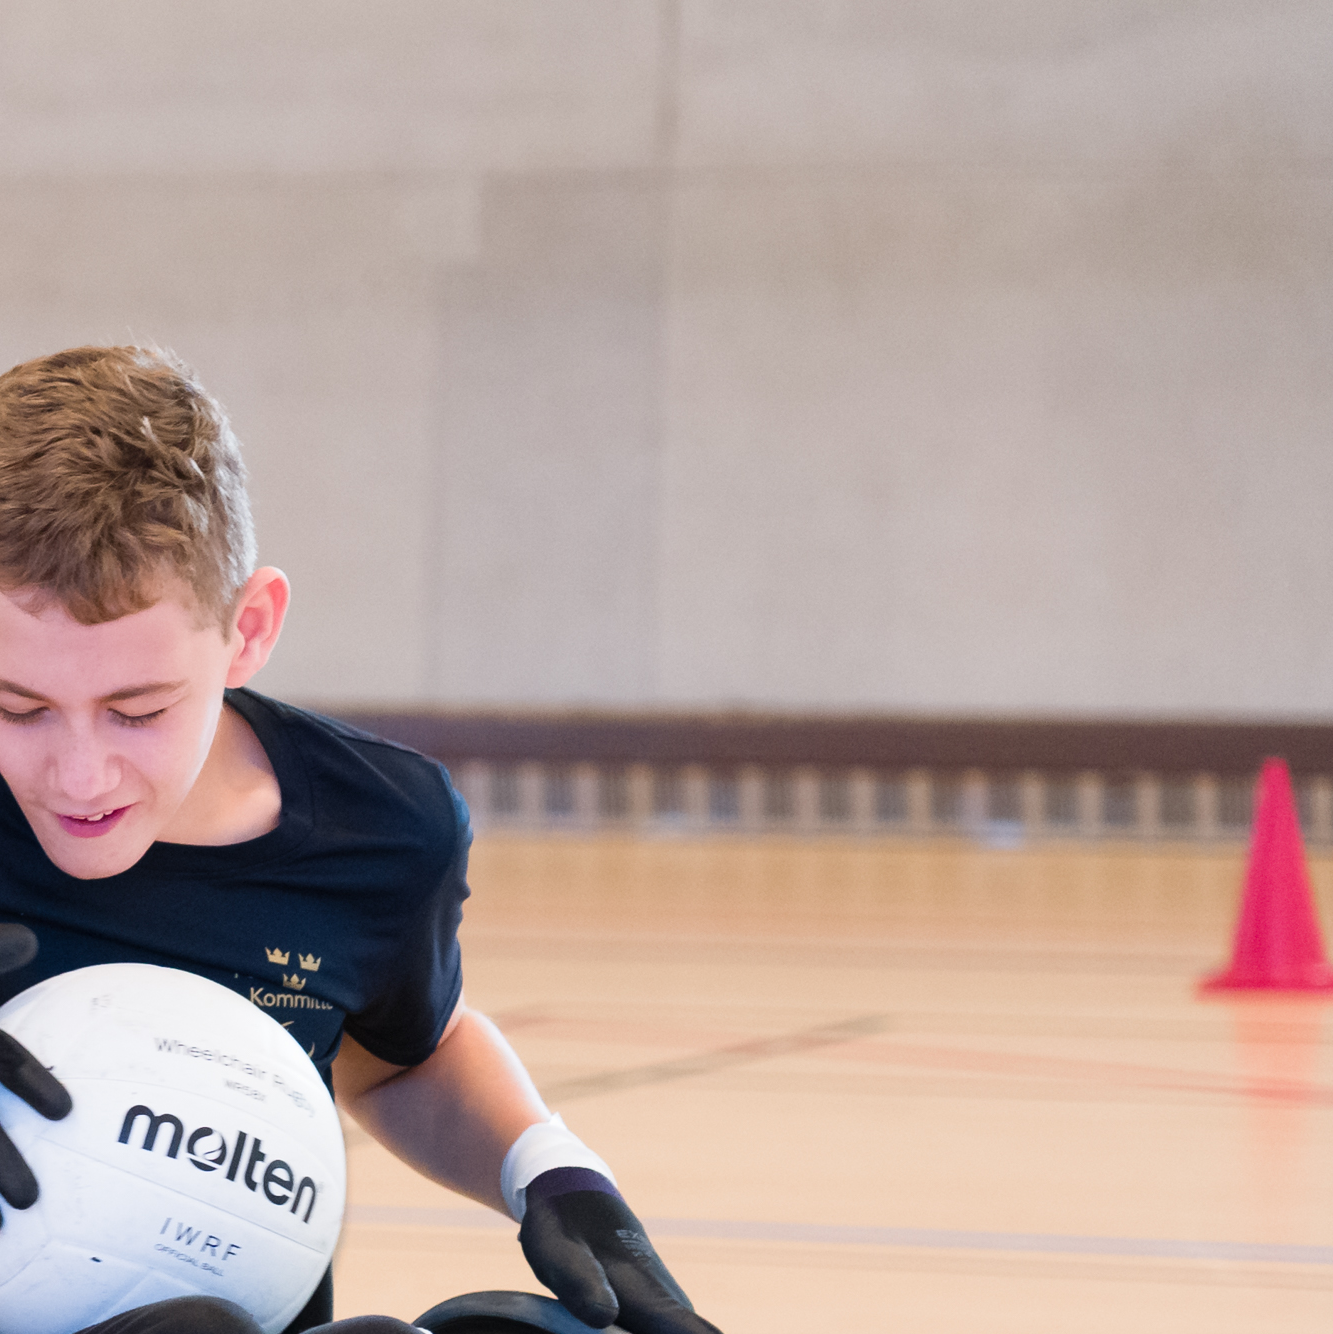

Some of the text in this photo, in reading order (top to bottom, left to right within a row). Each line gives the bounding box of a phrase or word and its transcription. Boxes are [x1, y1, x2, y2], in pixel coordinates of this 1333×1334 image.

[154, 1037, 316, 1118] Wheelchair Rugby
[118, 1104, 316, 1224] molten
[159, 1217, 242, 1261] IWRF
